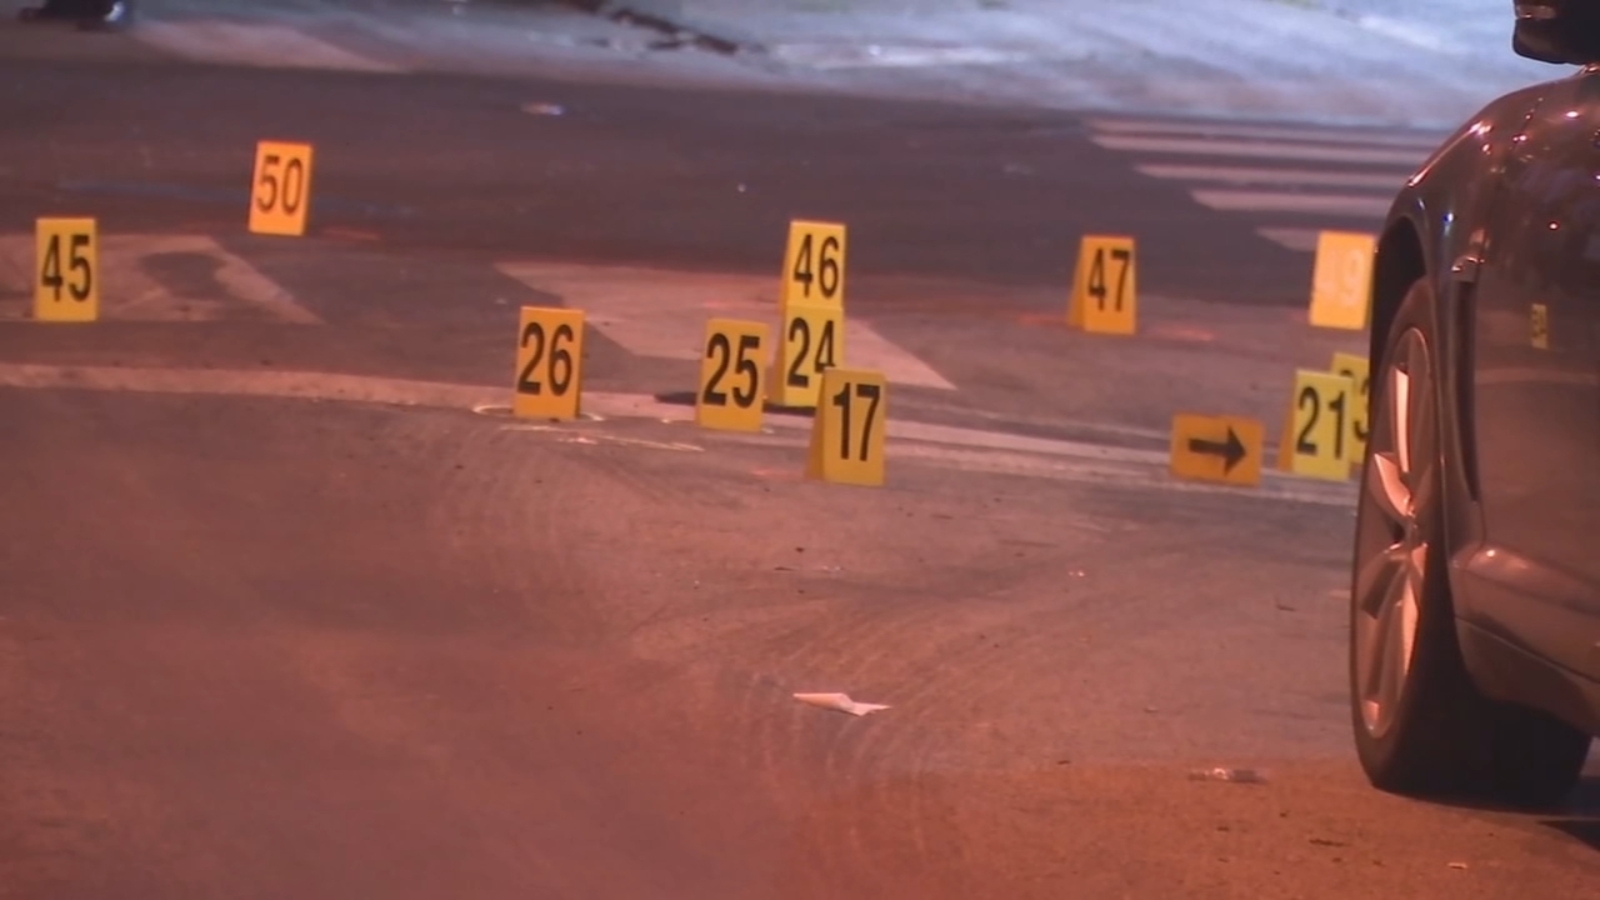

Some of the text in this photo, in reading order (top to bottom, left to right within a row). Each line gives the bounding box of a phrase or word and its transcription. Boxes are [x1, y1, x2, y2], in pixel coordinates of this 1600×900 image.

[255, 154, 304, 216] 50
[41, 233, 92, 303] 45
[792, 233, 840, 299] 46
[1087, 247, 1131, 313] 47
[516, 321, 574, 396] 26
[702, 332, 760, 409] 25
[786, 317, 836, 389] 24
[832, 382, 881, 462] 17
[1295, 386, 1346, 461] 21
